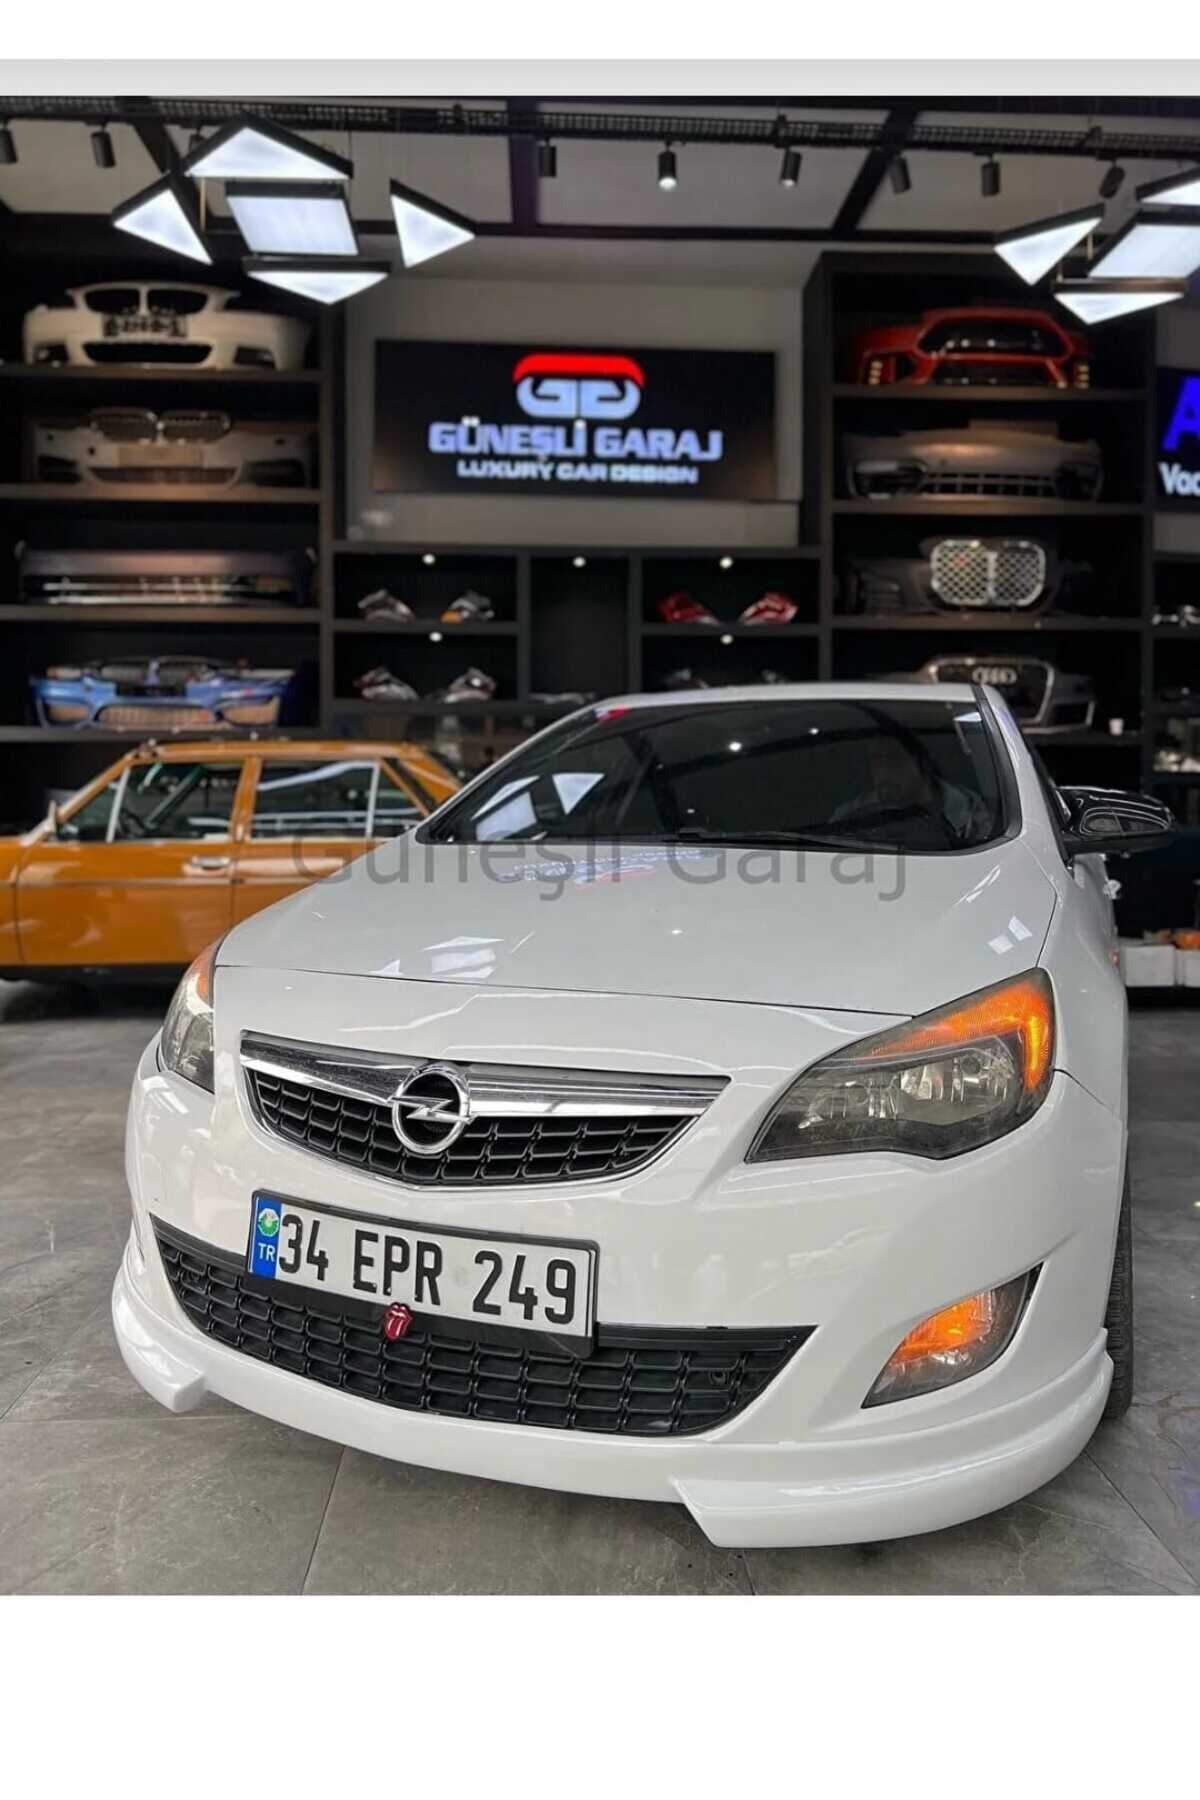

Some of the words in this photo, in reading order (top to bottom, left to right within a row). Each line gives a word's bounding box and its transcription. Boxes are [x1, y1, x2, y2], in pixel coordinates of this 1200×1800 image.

[428, 416, 588, 462] GÜNEŞLİ
[593, 427, 723, 461] GARAJ
[457, 460, 554, 482] LUXURY
[557, 461, 608, 482] CAR
[611, 464, 698, 484] DESIGN
[258, 1242, 277, 1263] TR
[278, 1213, 329, 1281] 34
[353, 1229, 443, 1306] EPR
[472, 1249, 577, 1325] 249
